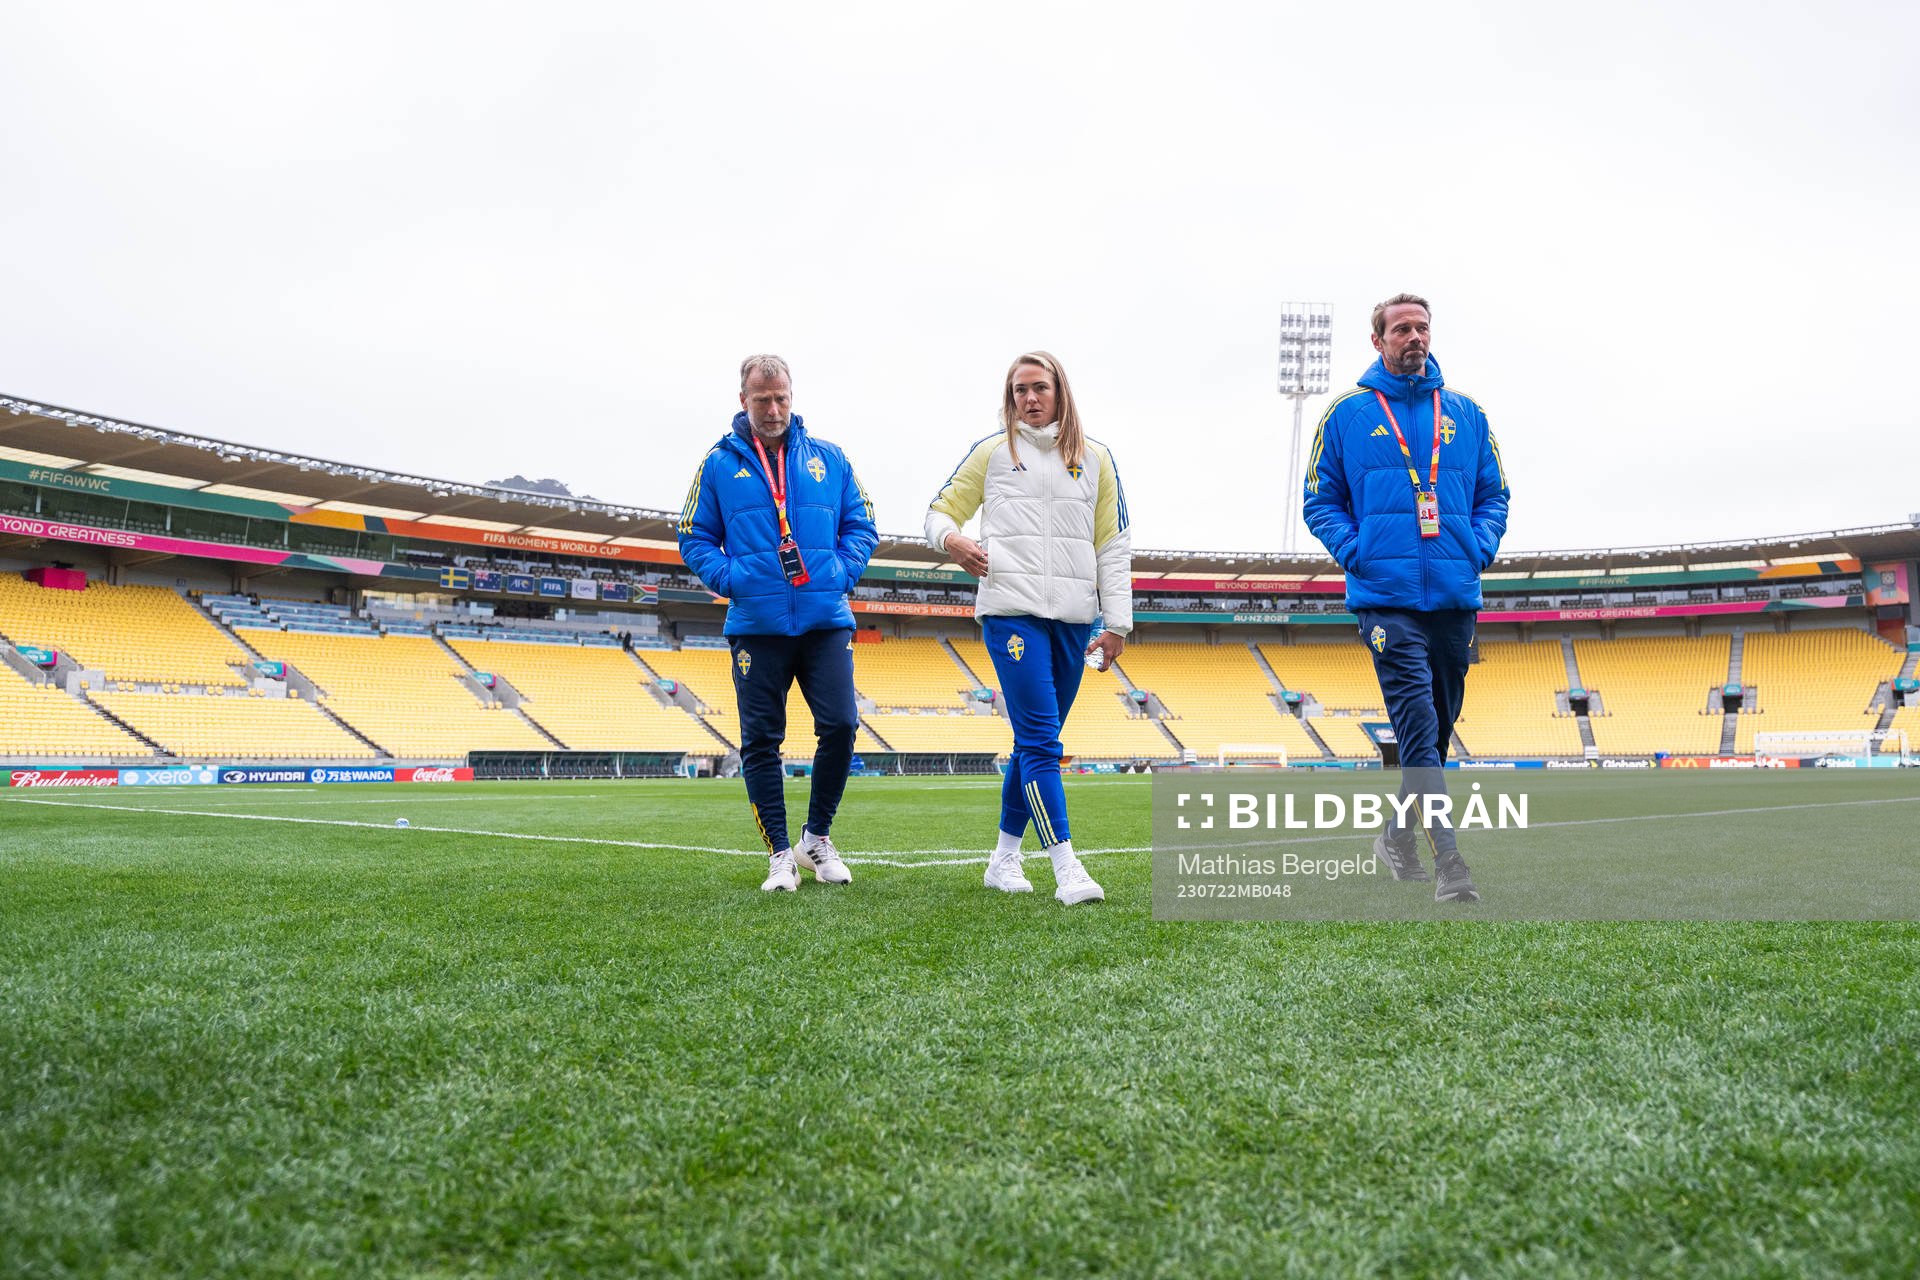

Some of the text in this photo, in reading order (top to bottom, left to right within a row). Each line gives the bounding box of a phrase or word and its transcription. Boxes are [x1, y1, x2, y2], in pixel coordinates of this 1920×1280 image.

[28, 468, 112, 491] #FIFAWWC
[0, 517, 137, 546] YOND GREATNESS
[483, 532, 621, 556] FIFA WOMEN'S WORLD CUP
[543, 582, 562, 592] FIFA
[1214, 582, 1250, 590] BEYOND
[866, 603, 975, 616] FIFA WOMEN'S WORLD CU
[1560, 610, 1598, 620] BEYOND
[11, 770, 118, 788] Budweiser
[145, 770, 193, 785] xero
[249, 771, 305, 782] HYUNDAI
[351, 770, 393, 782] WANDA
[412, 768, 455, 782] Coca-Cola
